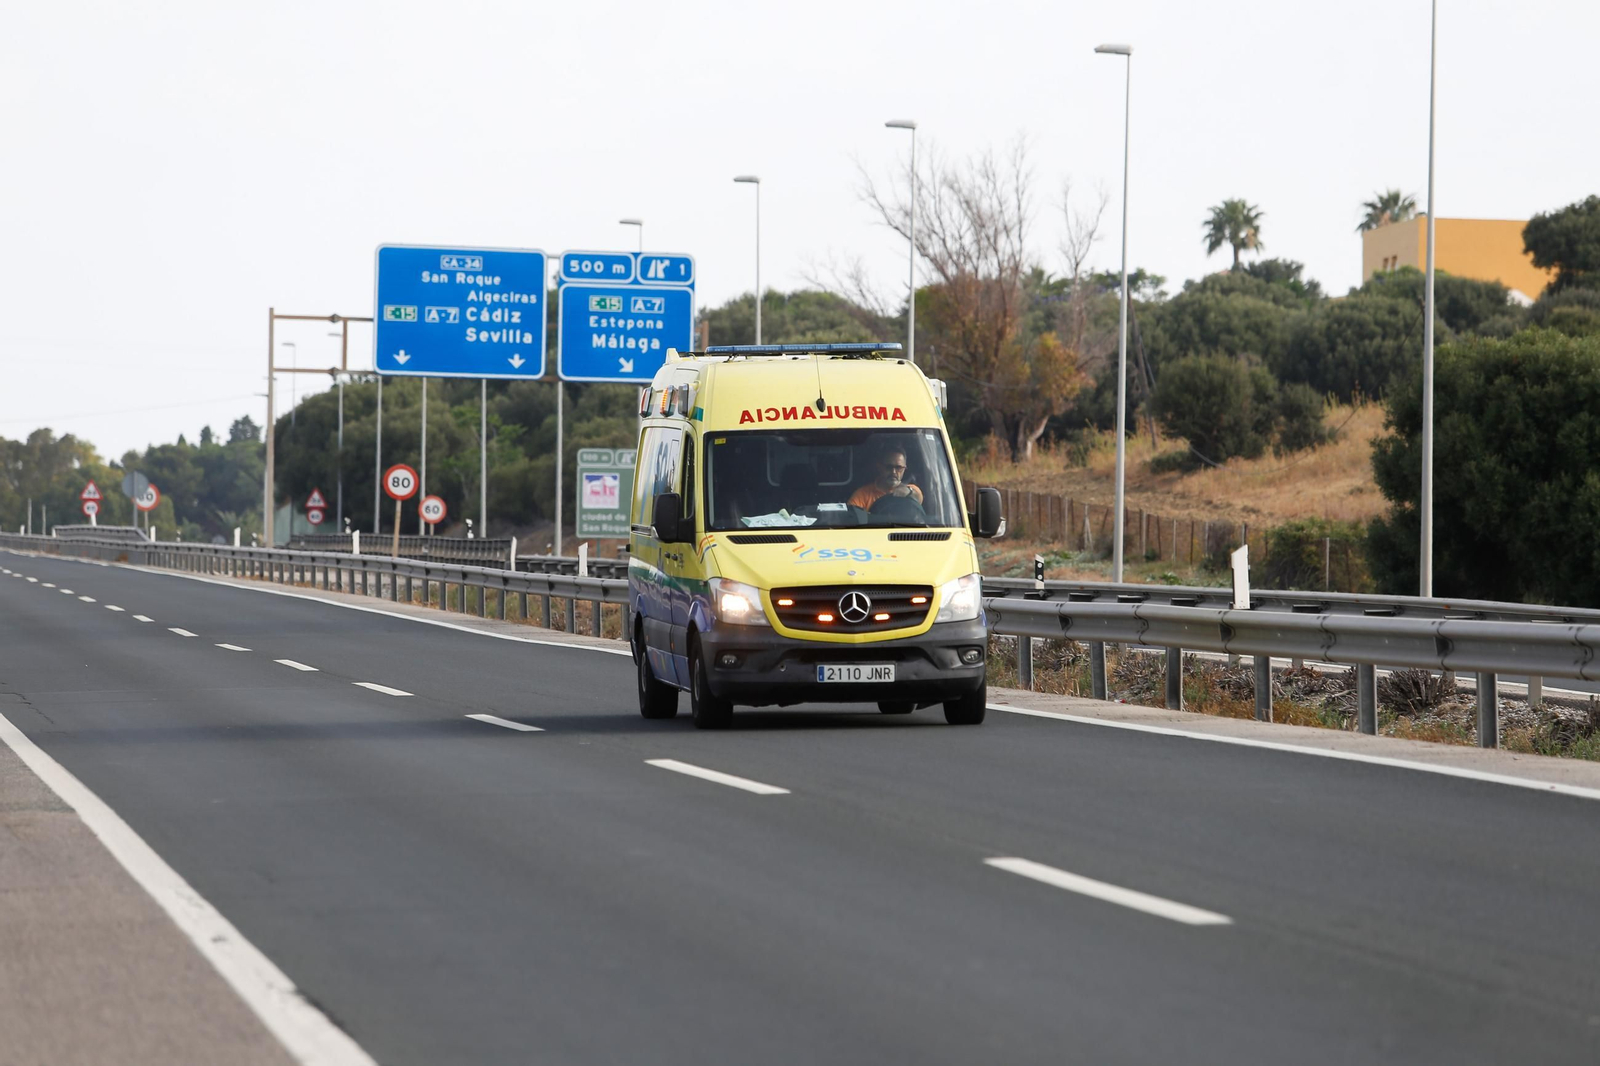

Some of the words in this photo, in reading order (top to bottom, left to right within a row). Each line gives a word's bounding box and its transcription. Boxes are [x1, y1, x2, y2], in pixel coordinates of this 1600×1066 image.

[442, 257, 481, 269] CA-34
[570, 260, 604, 274] 500
[612, 263, 626, 275] m
[679, 263, 686, 276] 1
[421, 271, 448, 283] San
[456, 272, 501, 286] Roque
[467, 290, 538, 304] Algeciras
[633, 299, 663, 312] A-7
[427, 309, 457, 322] A-7
[465, 306, 522, 322] Cádiz
[589, 315, 664, 332] Estepona
[465, 328, 533, 344] Sevilla
[592, 332, 661, 354] Málaga
[392, 476, 411, 489] 80
[425, 505, 440, 514] 60
[582, 513, 612, 521] ciudad
[615, 513, 626, 521] de
[582, 524, 600, 532] San
[817, 548, 872, 562] ssg
[827, 667, 861, 681] 2110
[866, 667, 891, 680] JNR
